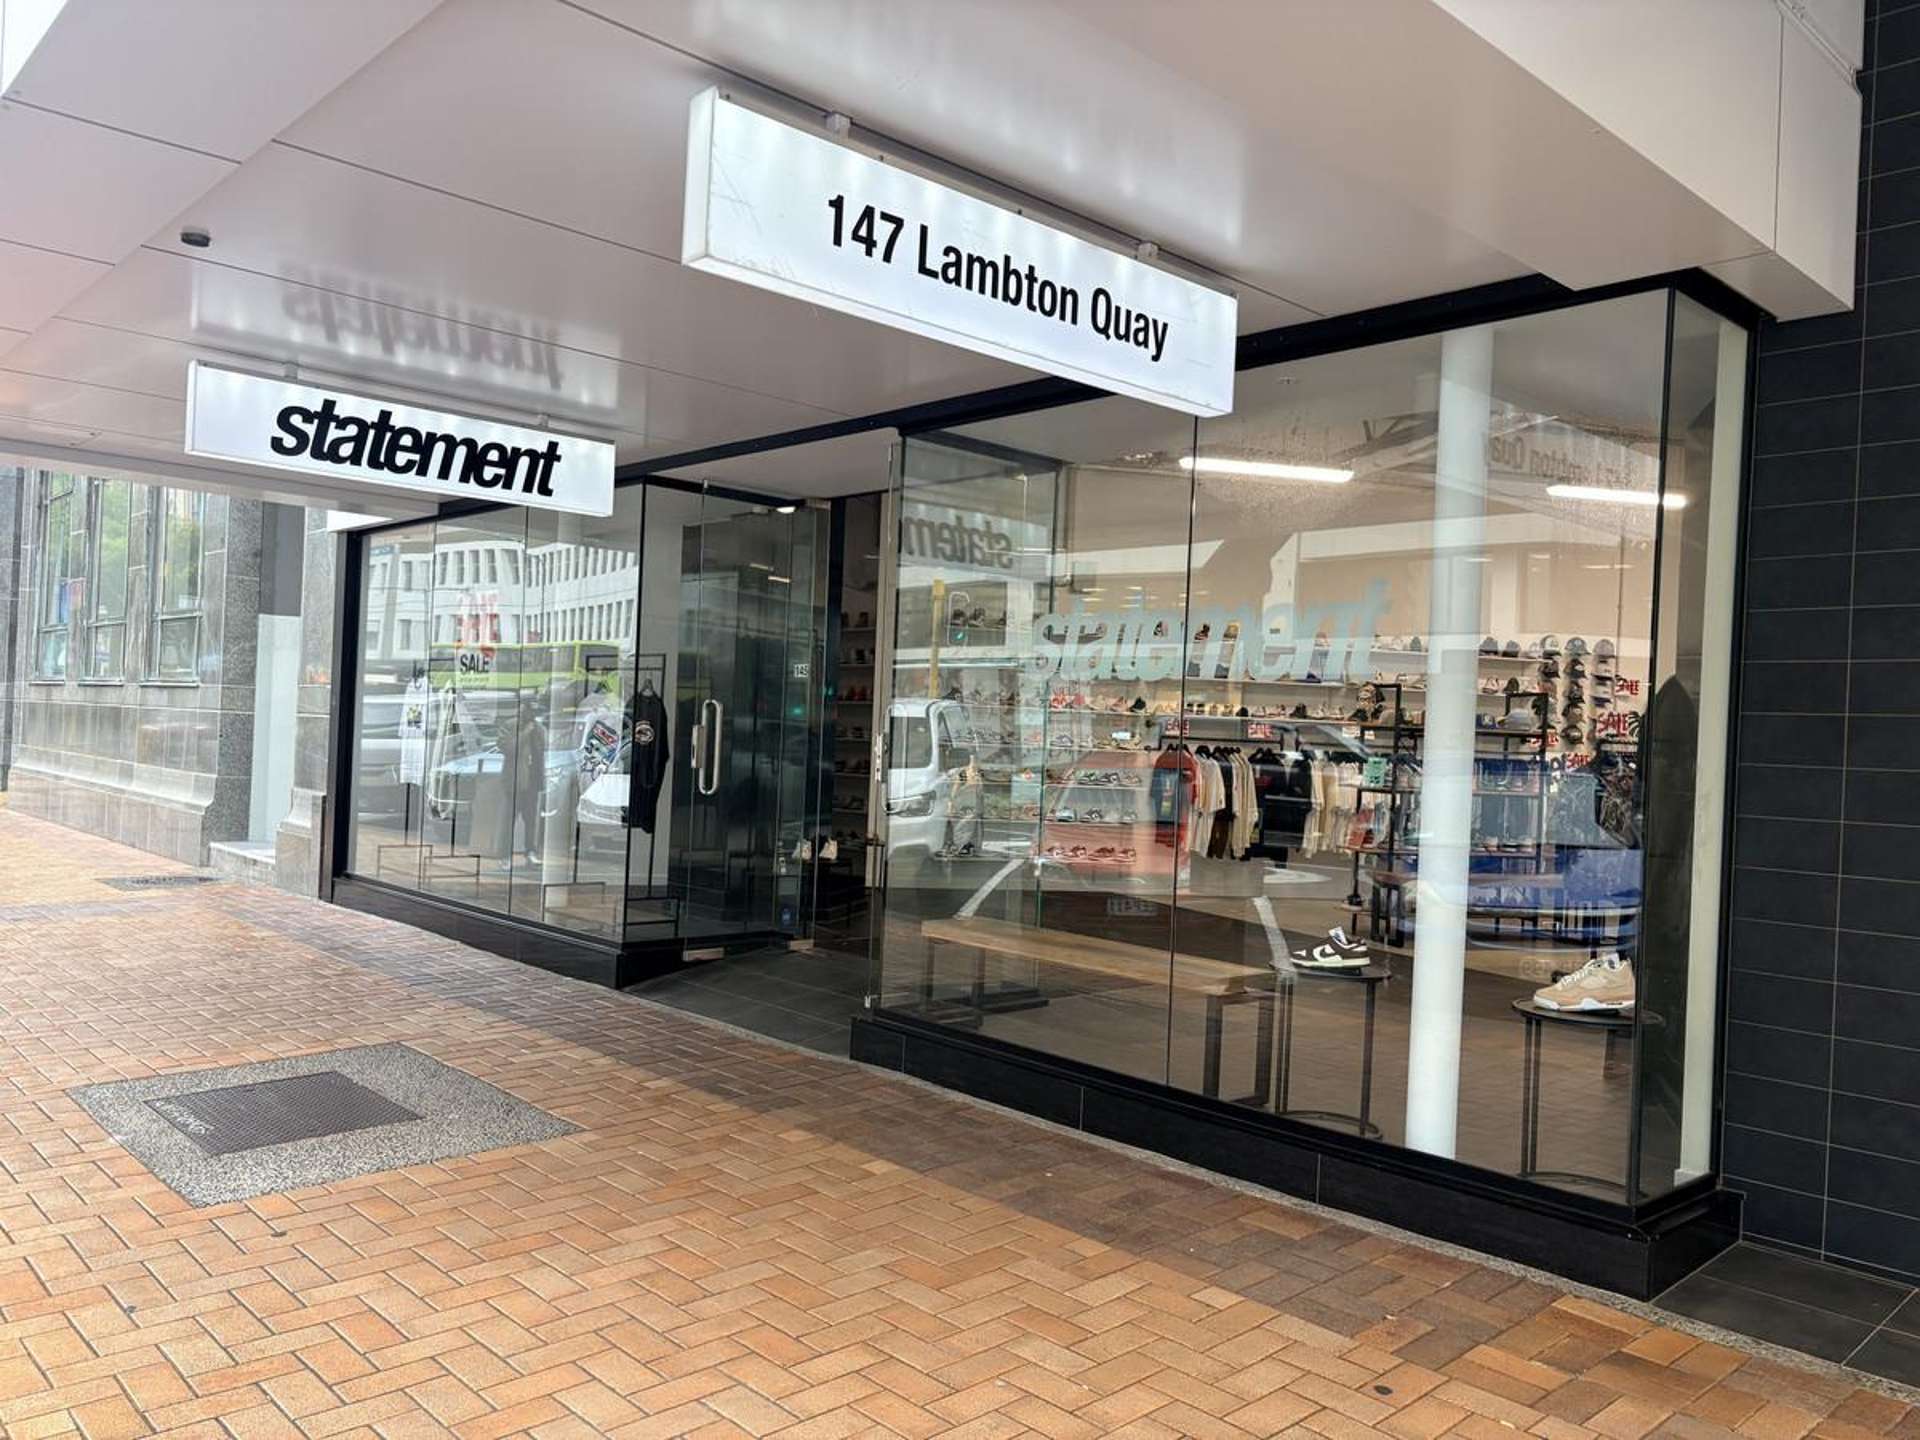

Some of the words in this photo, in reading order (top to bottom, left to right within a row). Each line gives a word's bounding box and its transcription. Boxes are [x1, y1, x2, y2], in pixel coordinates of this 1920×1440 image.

[828, 194, 904, 263] 147
[918, 223, 1078, 325] Lambton
[1090, 287, 1169, 362] Quay
[270, 399, 561, 497] statement
[460, 654, 489, 674] SALE
[1029, 577, 1393, 681] statement
